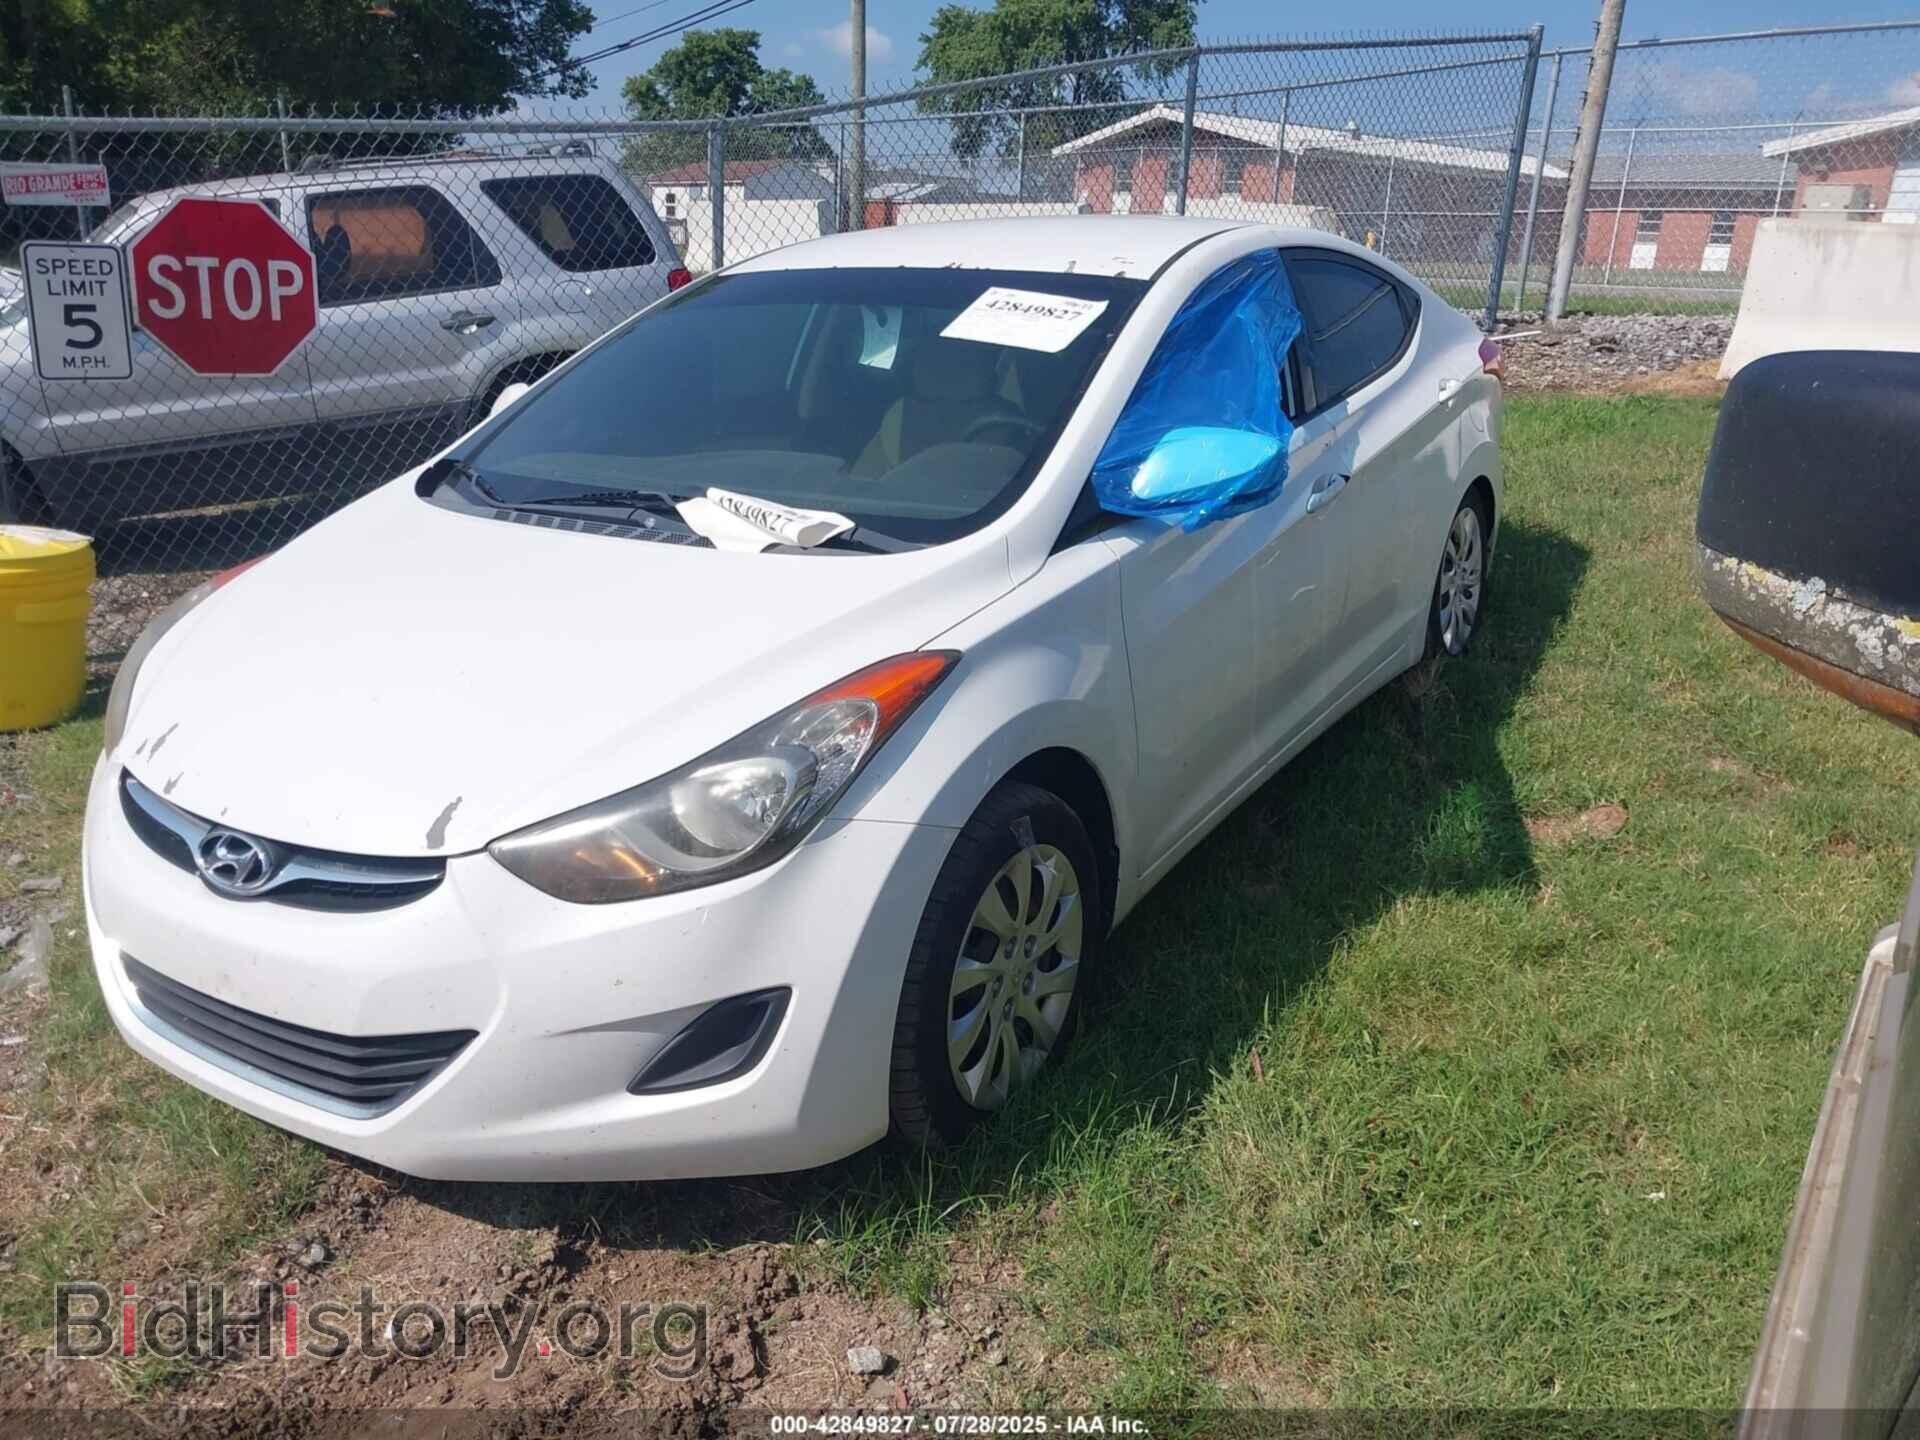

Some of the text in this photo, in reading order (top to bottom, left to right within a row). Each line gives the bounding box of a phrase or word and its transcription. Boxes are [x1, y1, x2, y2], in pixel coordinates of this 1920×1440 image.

[6, 176, 26, 192] RIO
[28, 173, 76, 192] GRANDE
[36, 258, 113, 276] SPEED
[47, 280, 107, 297] LIMIT
[147, 254, 304, 321] STOP
[985, 299, 1083, 321] 42849827
[63, 304, 103, 349] 5
[62, 356, 110, 369] M.P.H.
